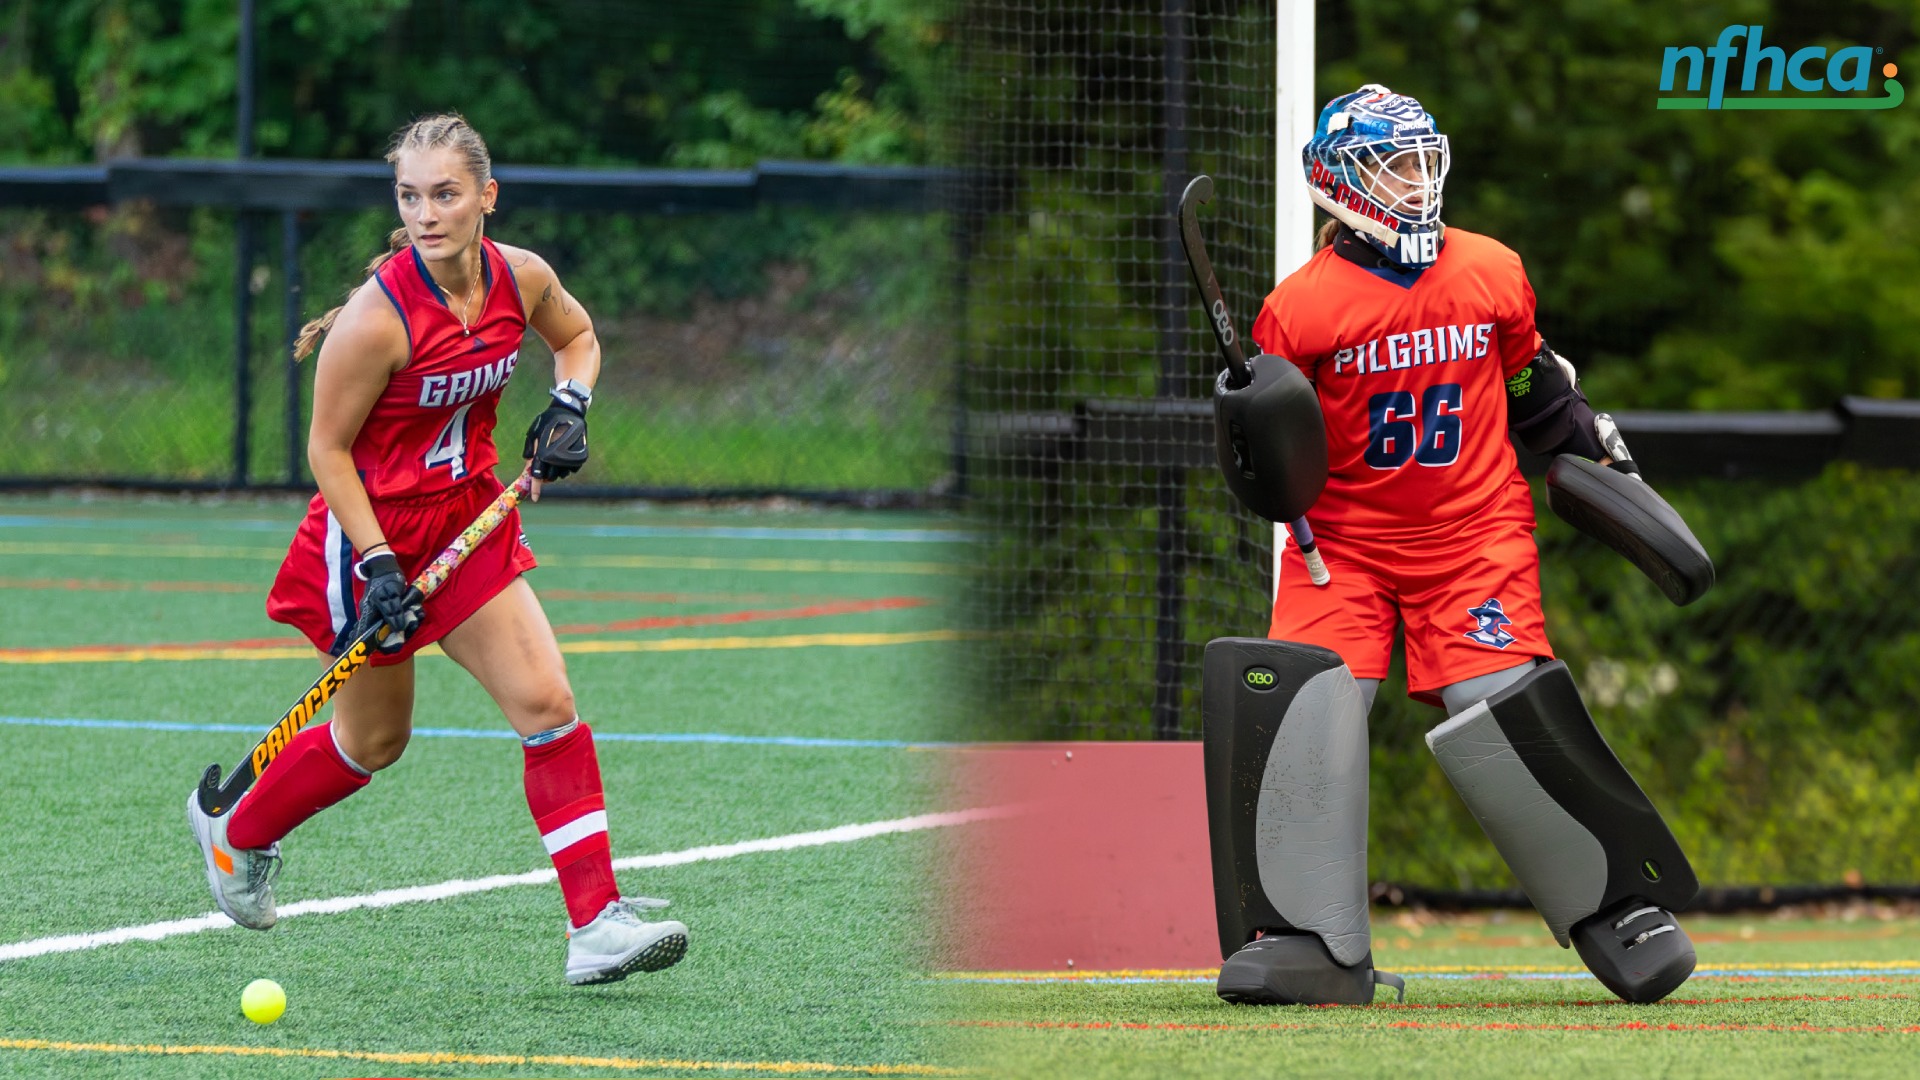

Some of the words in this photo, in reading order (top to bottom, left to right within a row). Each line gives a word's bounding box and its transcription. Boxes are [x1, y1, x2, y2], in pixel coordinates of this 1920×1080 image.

[1213, 299, 1234, 346] OBO
[1334, 322, 1496, 374] PILGRIMS
[418, 349, 519, 408] GRIMS
[425, 401, 476, 481] 4
[1363, 383, 1464, 471] 66
[1247, 672, 1274, 685] OBO
[251, 641, 368, 779] PRINCESS
